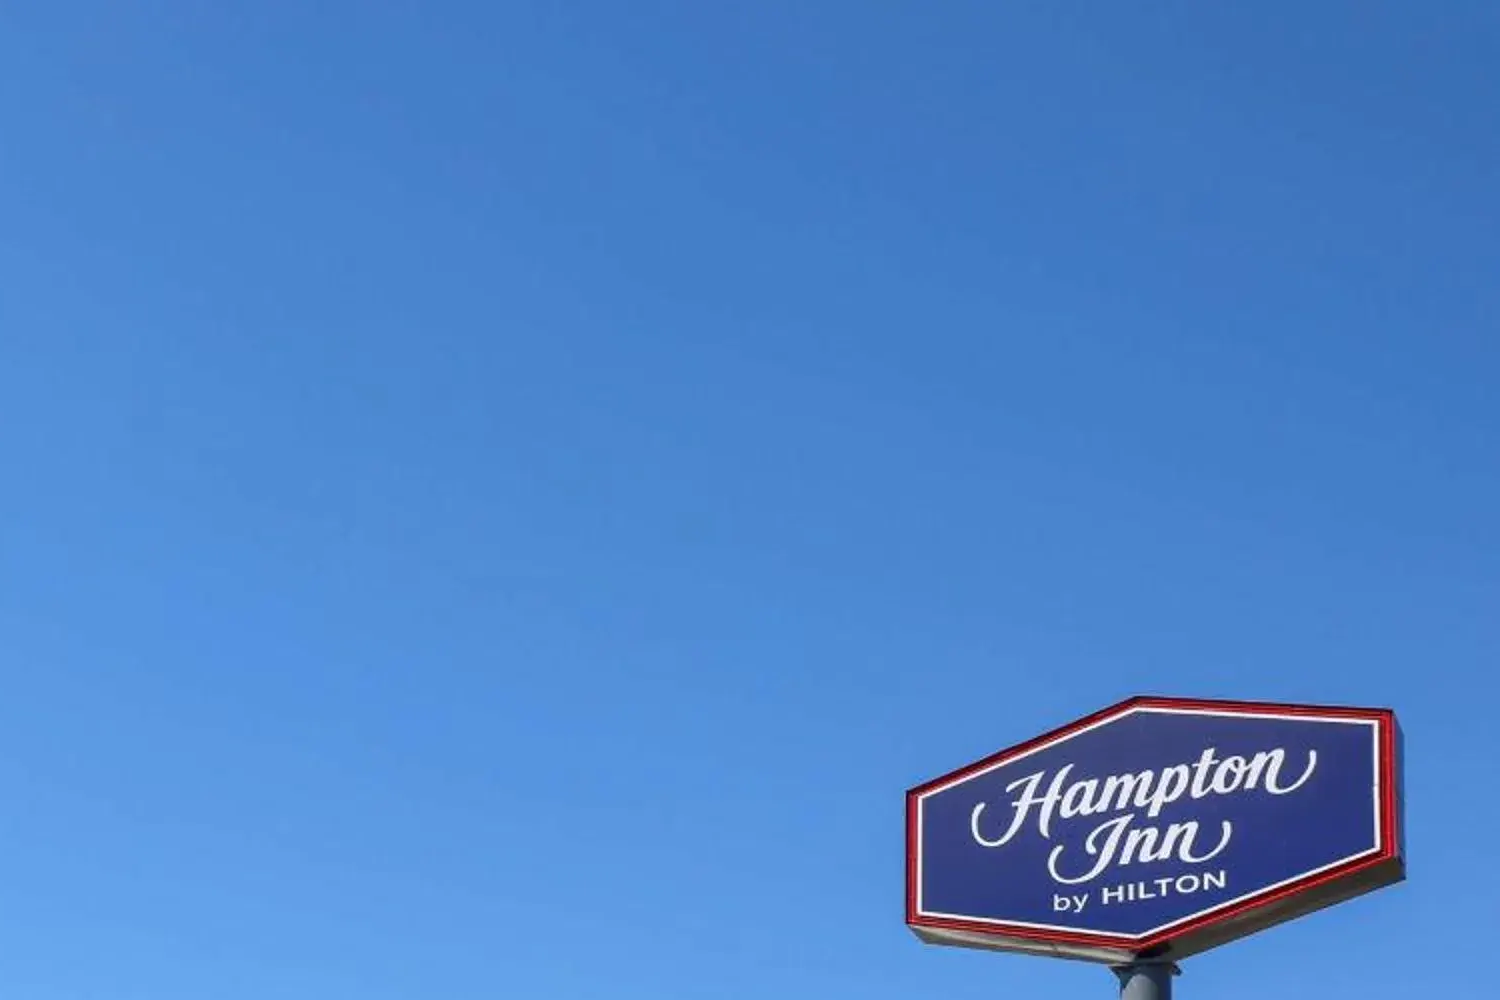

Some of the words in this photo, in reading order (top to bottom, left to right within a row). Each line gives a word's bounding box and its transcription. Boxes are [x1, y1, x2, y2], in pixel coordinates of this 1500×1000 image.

[971, 747, 1317, 846] Hampton
[1047, 814, 1232, 884] Inn
[1053, 893, 1088, 912] by
[1101, 871, 1226, 904] HILTON
